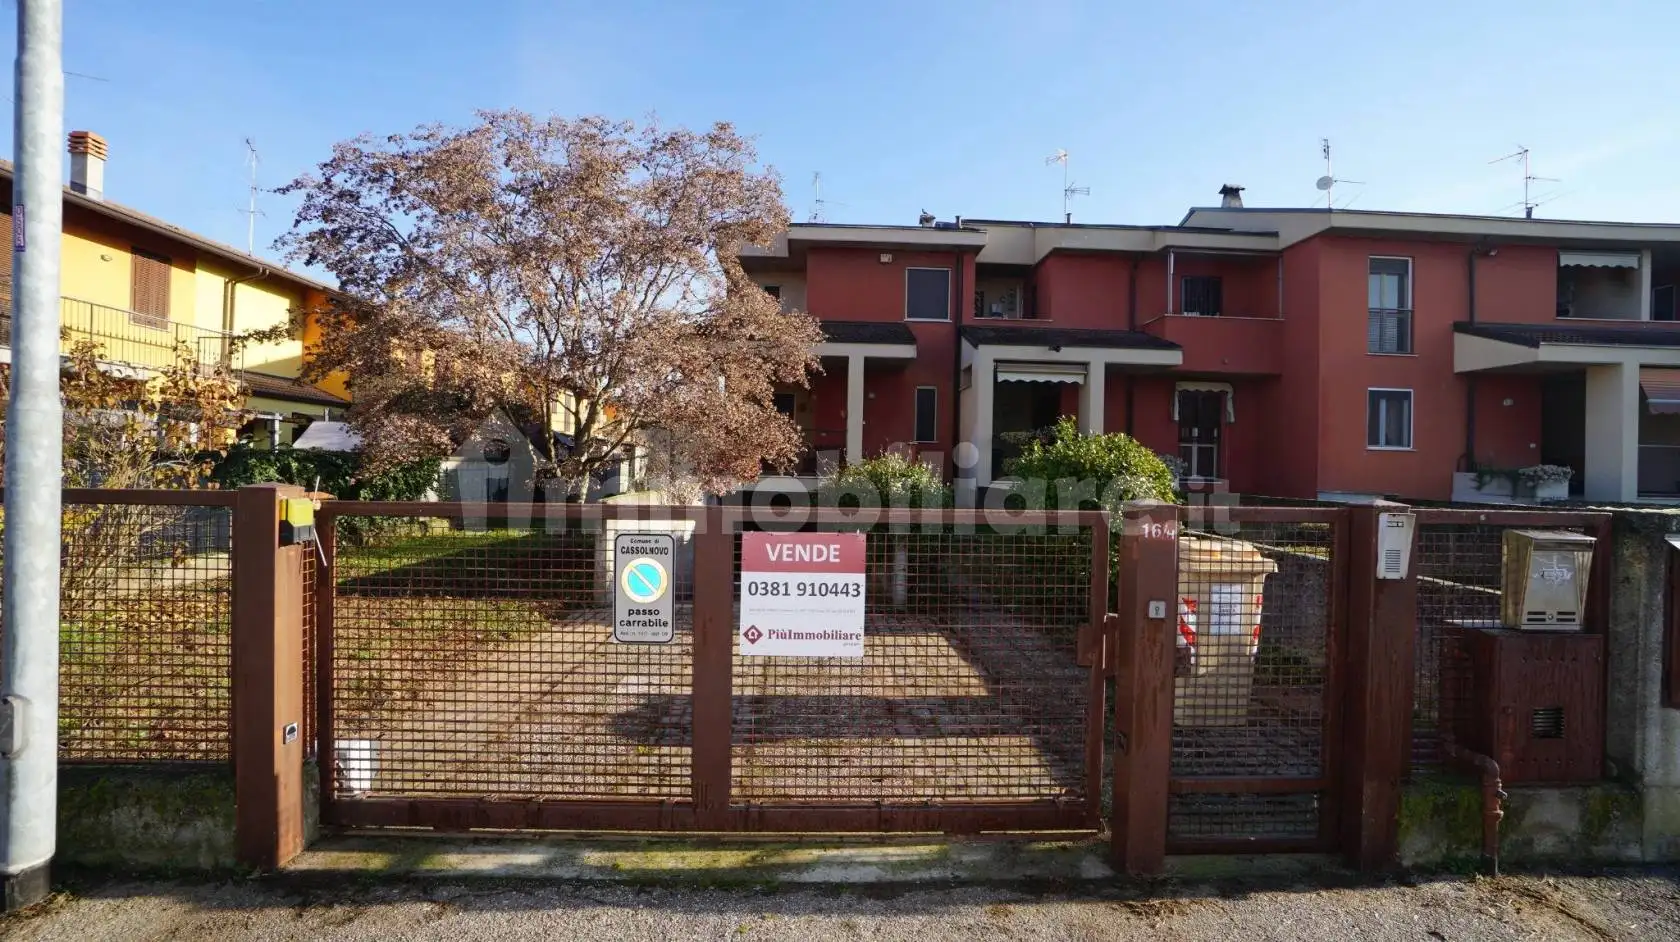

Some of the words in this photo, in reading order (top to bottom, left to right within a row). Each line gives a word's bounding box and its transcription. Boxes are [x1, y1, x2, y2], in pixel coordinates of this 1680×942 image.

[620, 546, 669, 556] CASSOLNOVO
[765, 543, 841, 563] VENDE
[747, 581, 791, 597] 0381
[796, 582, 861, 598] 910443
[627, 608, 660, 618] passo
[619, 618, 669, 628] carrabile
[767, 628, 862, 641] PiùImmobiliare
